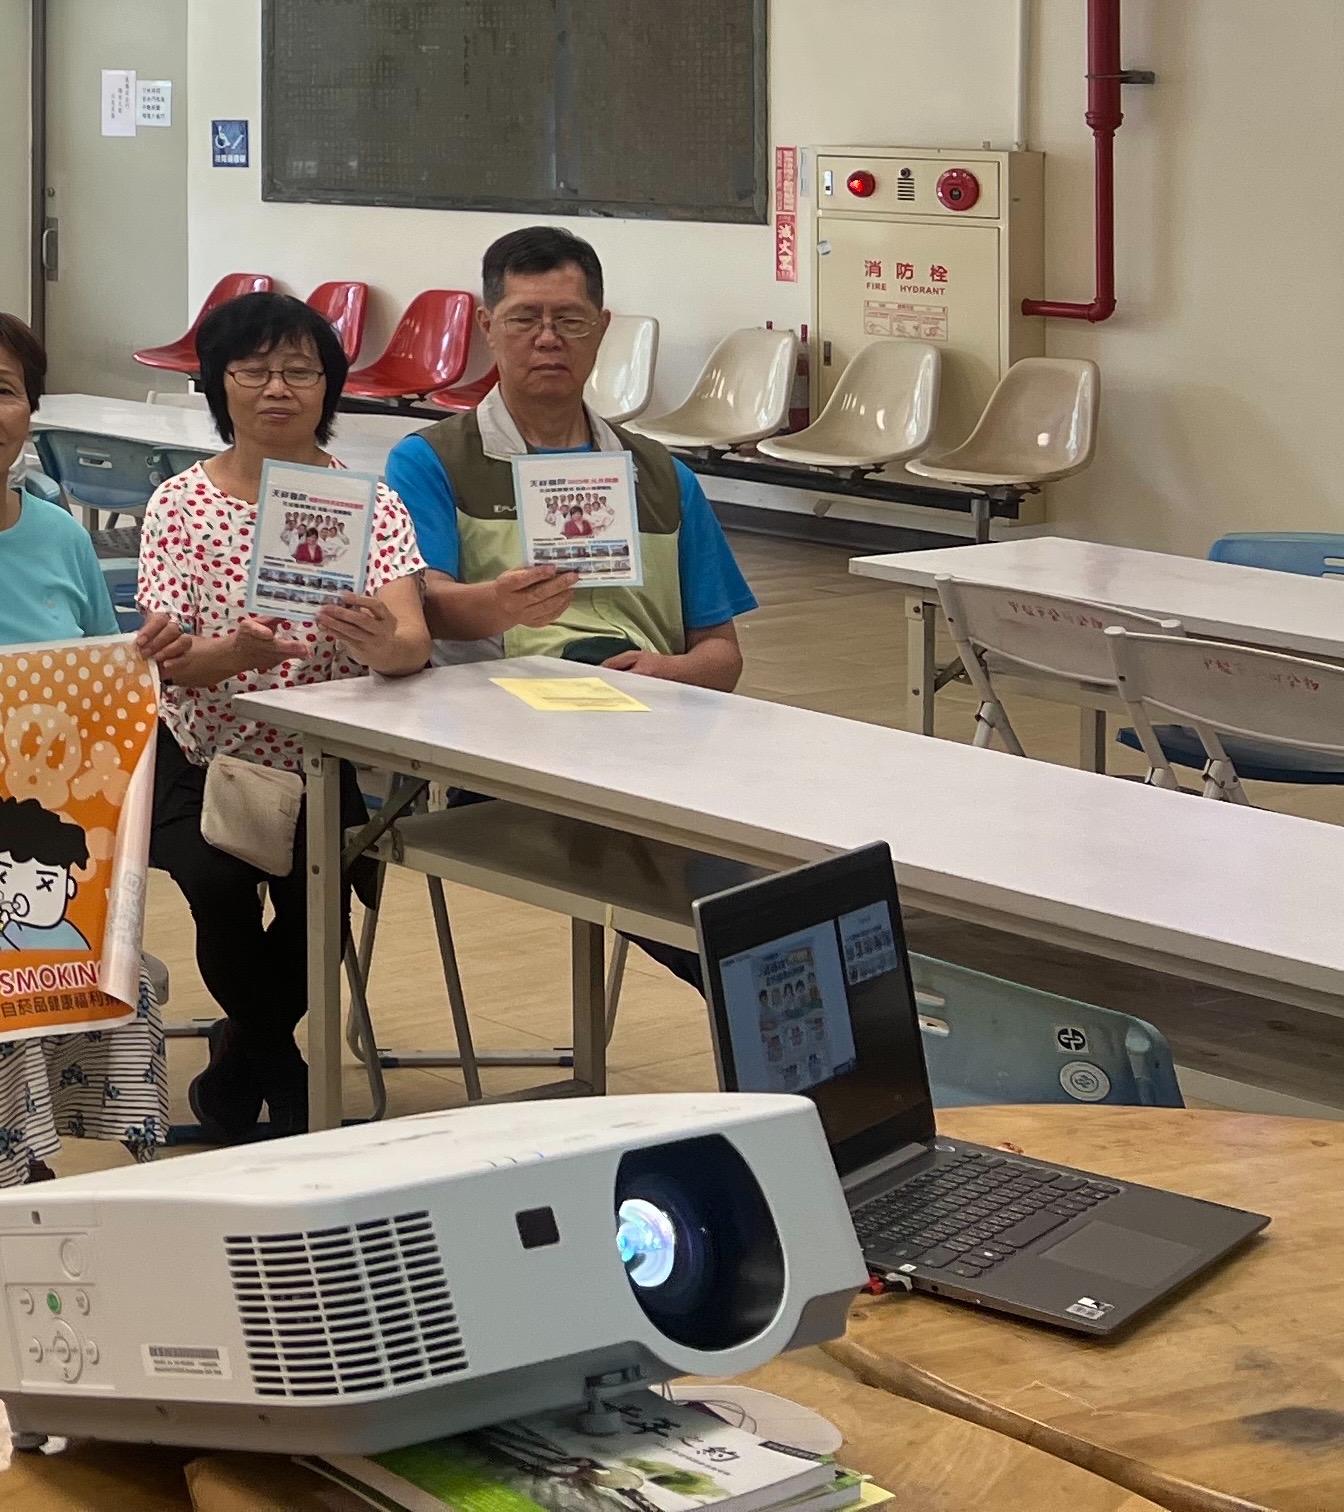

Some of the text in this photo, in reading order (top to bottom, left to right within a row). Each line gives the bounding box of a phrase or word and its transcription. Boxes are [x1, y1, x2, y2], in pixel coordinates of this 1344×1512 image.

[864, 260, 948, 282] 消防栓
[866, 282, 946, 296] FIRE HYDRANT
